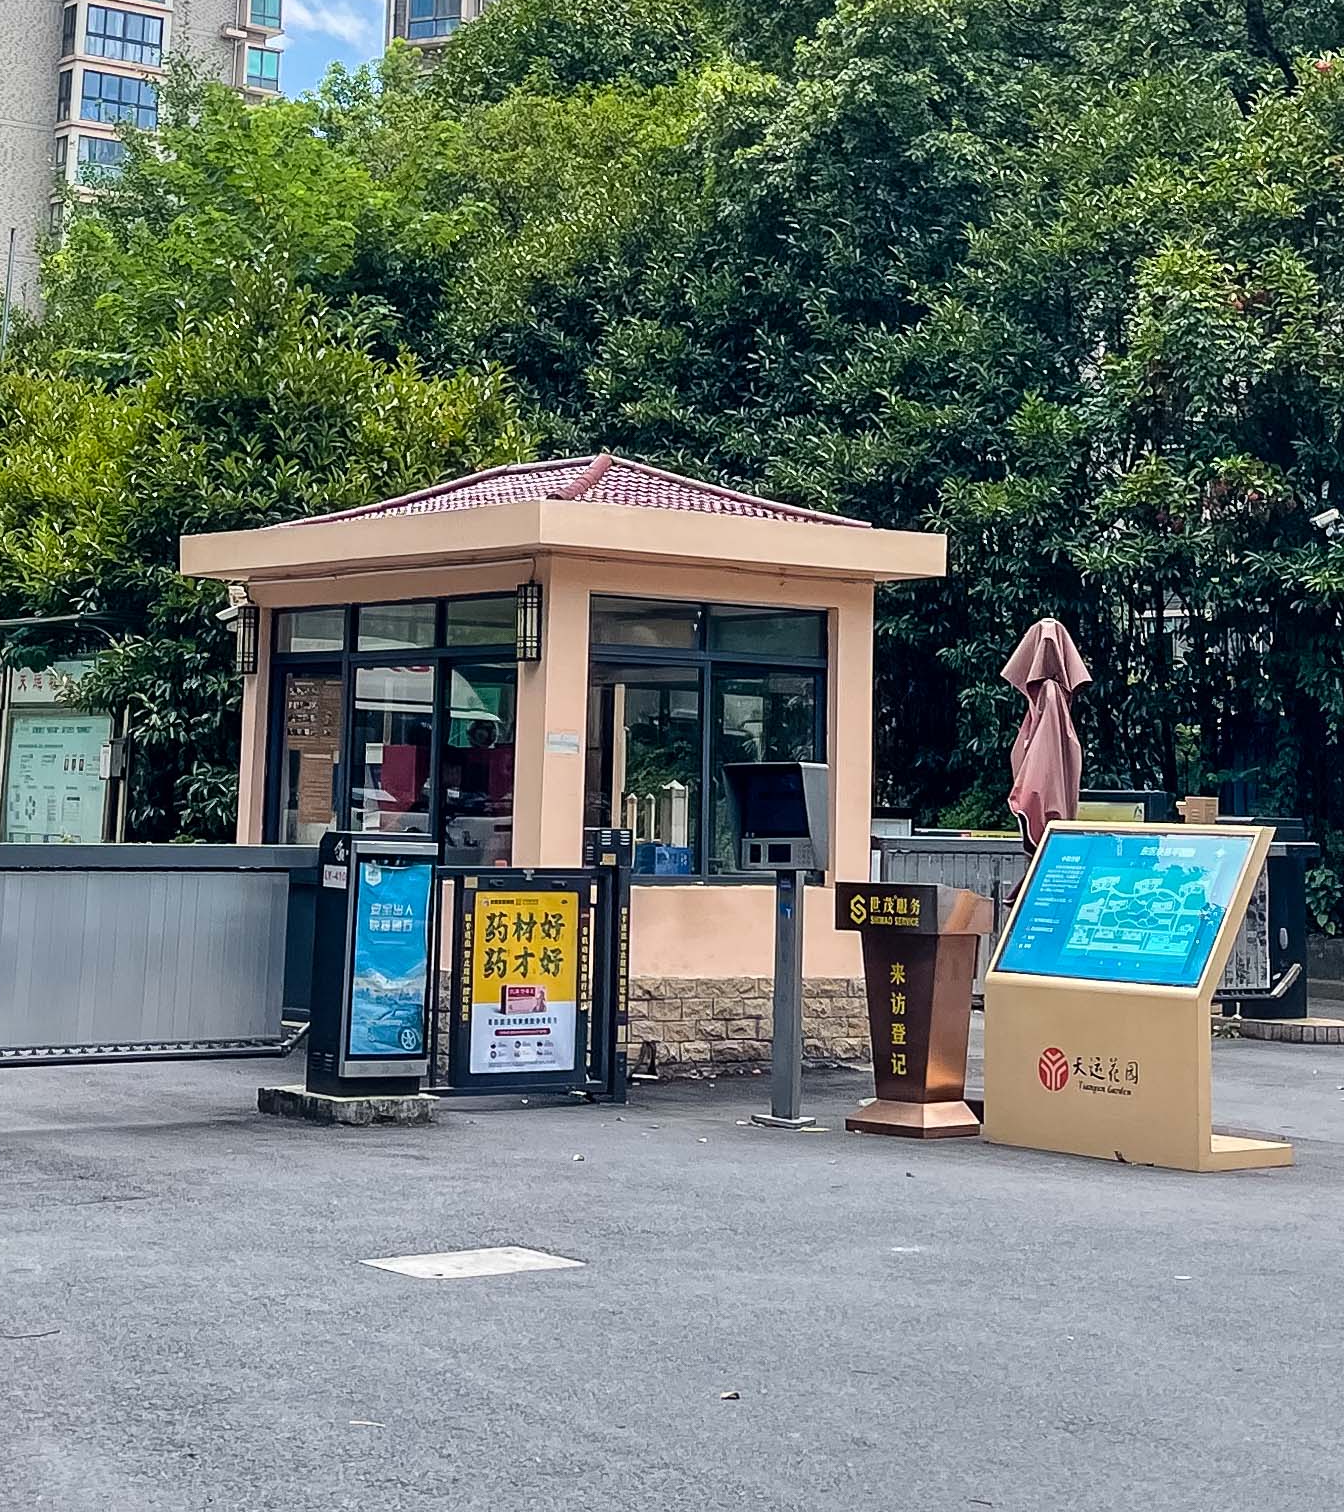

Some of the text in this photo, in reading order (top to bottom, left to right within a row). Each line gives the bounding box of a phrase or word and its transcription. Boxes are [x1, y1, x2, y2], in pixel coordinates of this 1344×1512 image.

[870, 895, 921, 915] 世茂服务
[484, 911, 566, 943] 药材好
[870, 915, 920, 926] SHIMAO SERVICE
[483, 946, 564, 979] 药才好
[889, 962, 908, 1076] 来访登记
[1072, 1056, 1139, 1085] 天运花园
